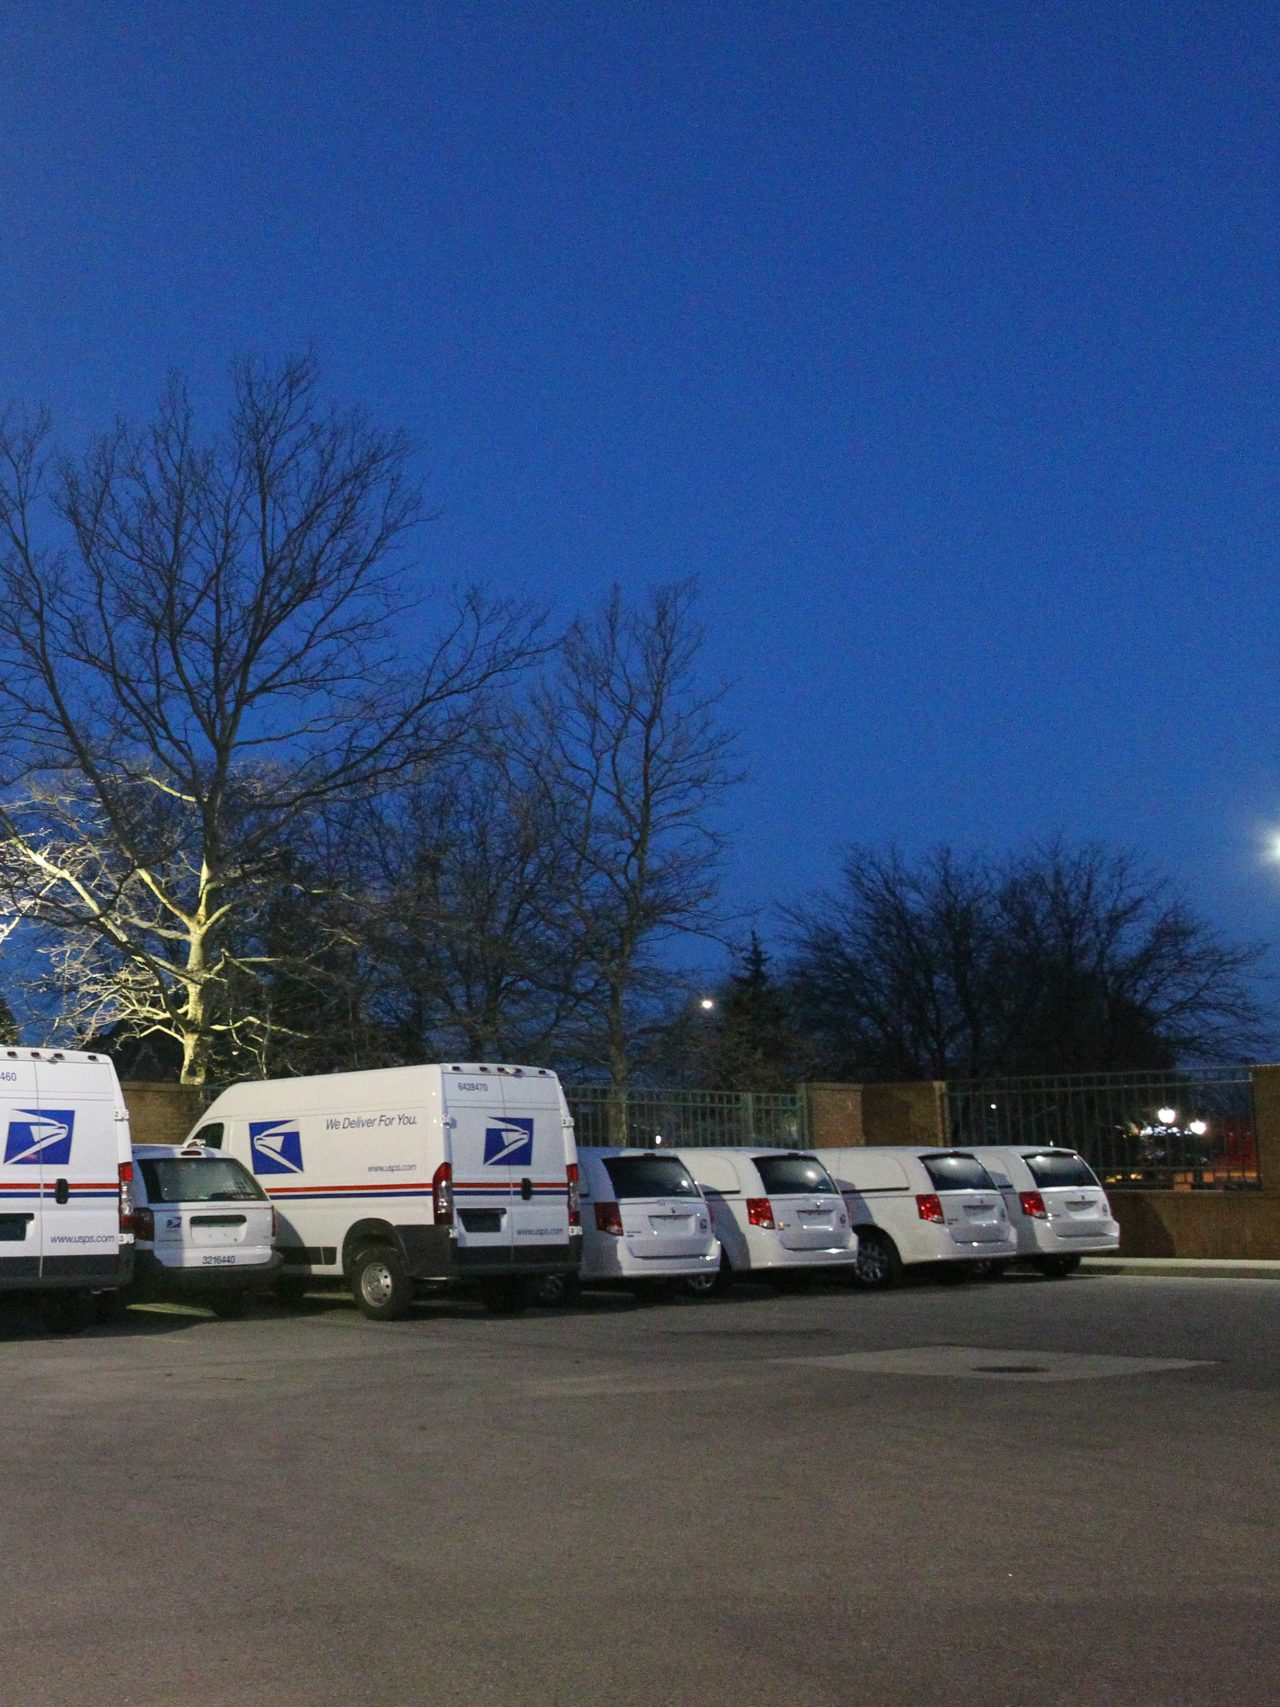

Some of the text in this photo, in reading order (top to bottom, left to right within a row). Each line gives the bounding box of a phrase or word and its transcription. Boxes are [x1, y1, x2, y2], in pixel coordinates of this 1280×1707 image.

[326, 1113, 417, 1130] We Deliver For You.
[367, 1164, 417, 1173] www.usps.com
[51, 1235, 115, 1245] www.usps.com
